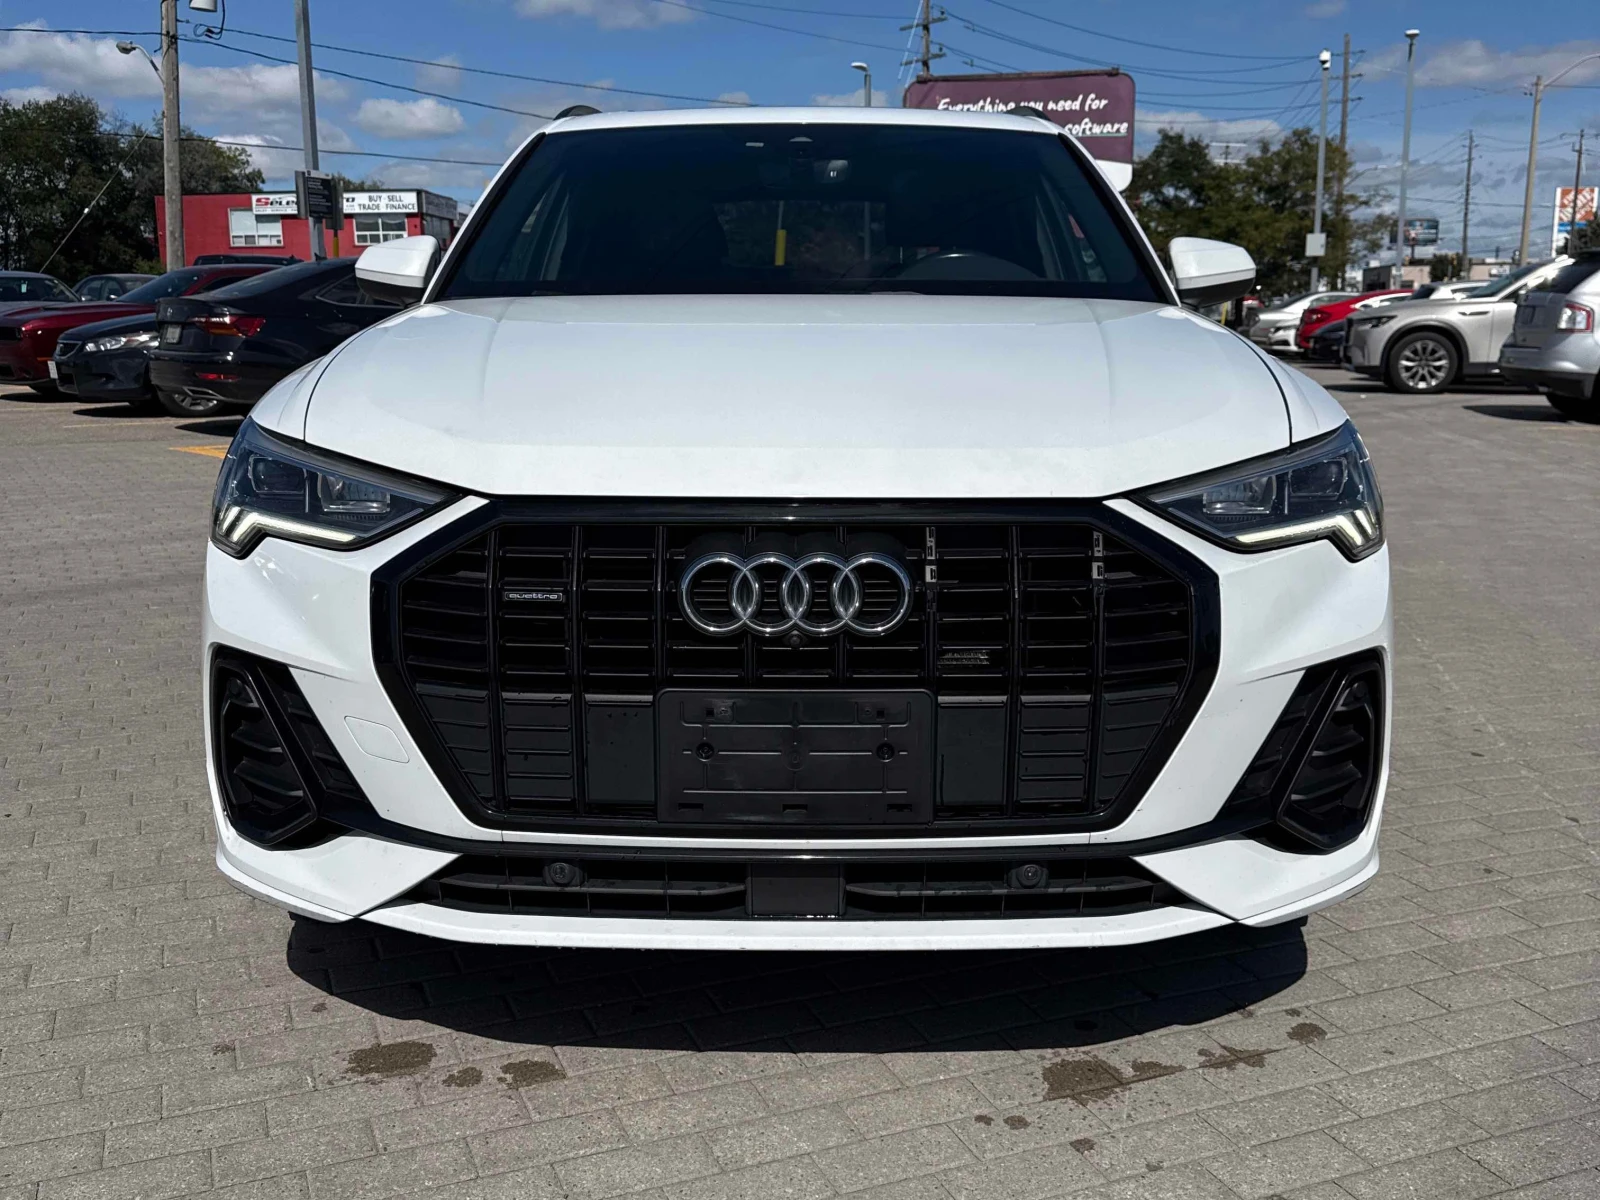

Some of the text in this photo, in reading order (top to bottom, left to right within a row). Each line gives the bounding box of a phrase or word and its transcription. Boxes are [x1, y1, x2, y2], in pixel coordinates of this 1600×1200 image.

[1047, 94, 1083, 111] need
[1085, 93, 1108, 112] for
[1064, 117, 1129, 137] software
[368, 194, 404, 203] BUY SELL
[357, 203, 381, 211] TRADE
[385, 203, 416, 211] FINANCE
